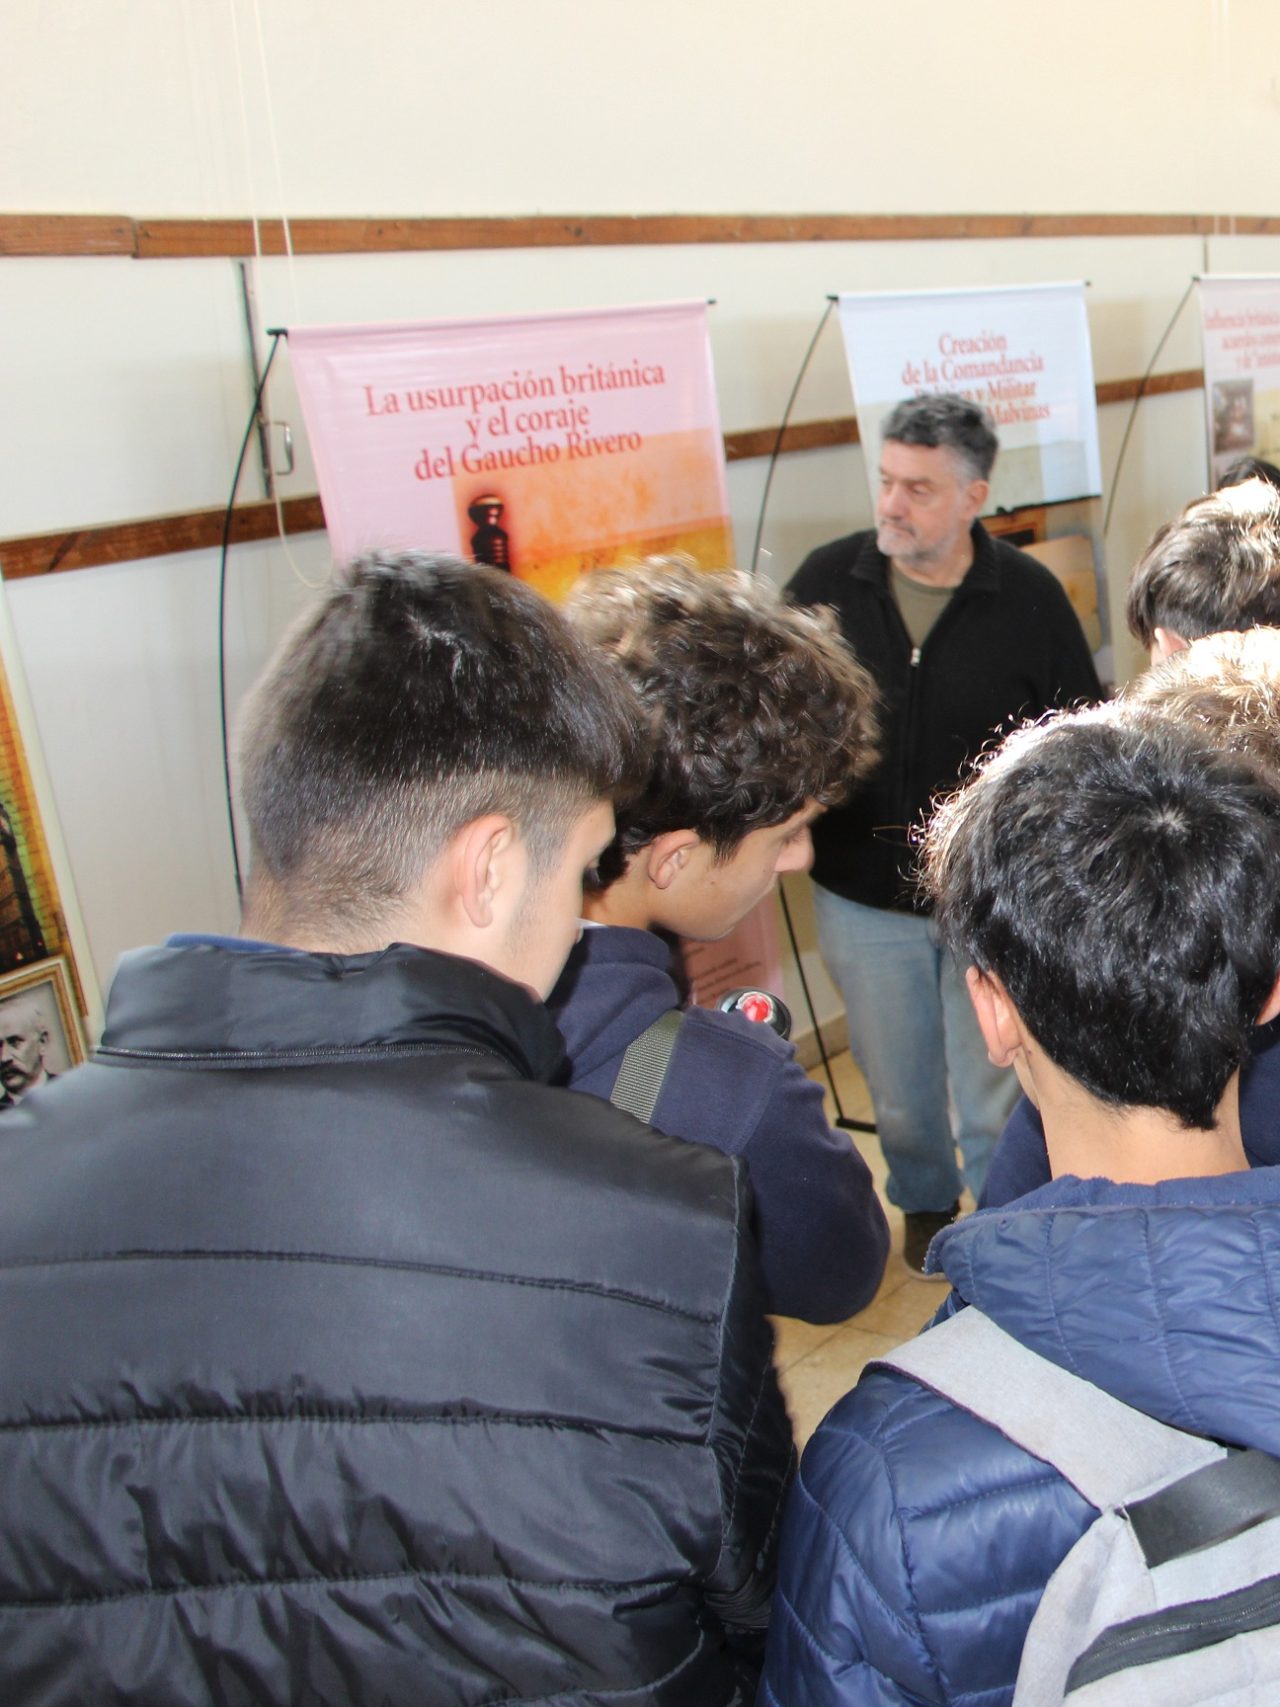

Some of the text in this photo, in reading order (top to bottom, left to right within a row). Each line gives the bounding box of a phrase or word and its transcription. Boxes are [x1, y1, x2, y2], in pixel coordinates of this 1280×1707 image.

[938, 329, 1008, 357] Creación
[902, 351, 1044, 386] de la Comandancia
[363, 358, 666, 417] La usurpación británica
[988, 379, 1037, 401] Militar
[465, 399, 590, 440] y el coraje
[986, 403, 1050, 424] Malvinas
[414, 428, 642, 481] del Gaucho Rivero
